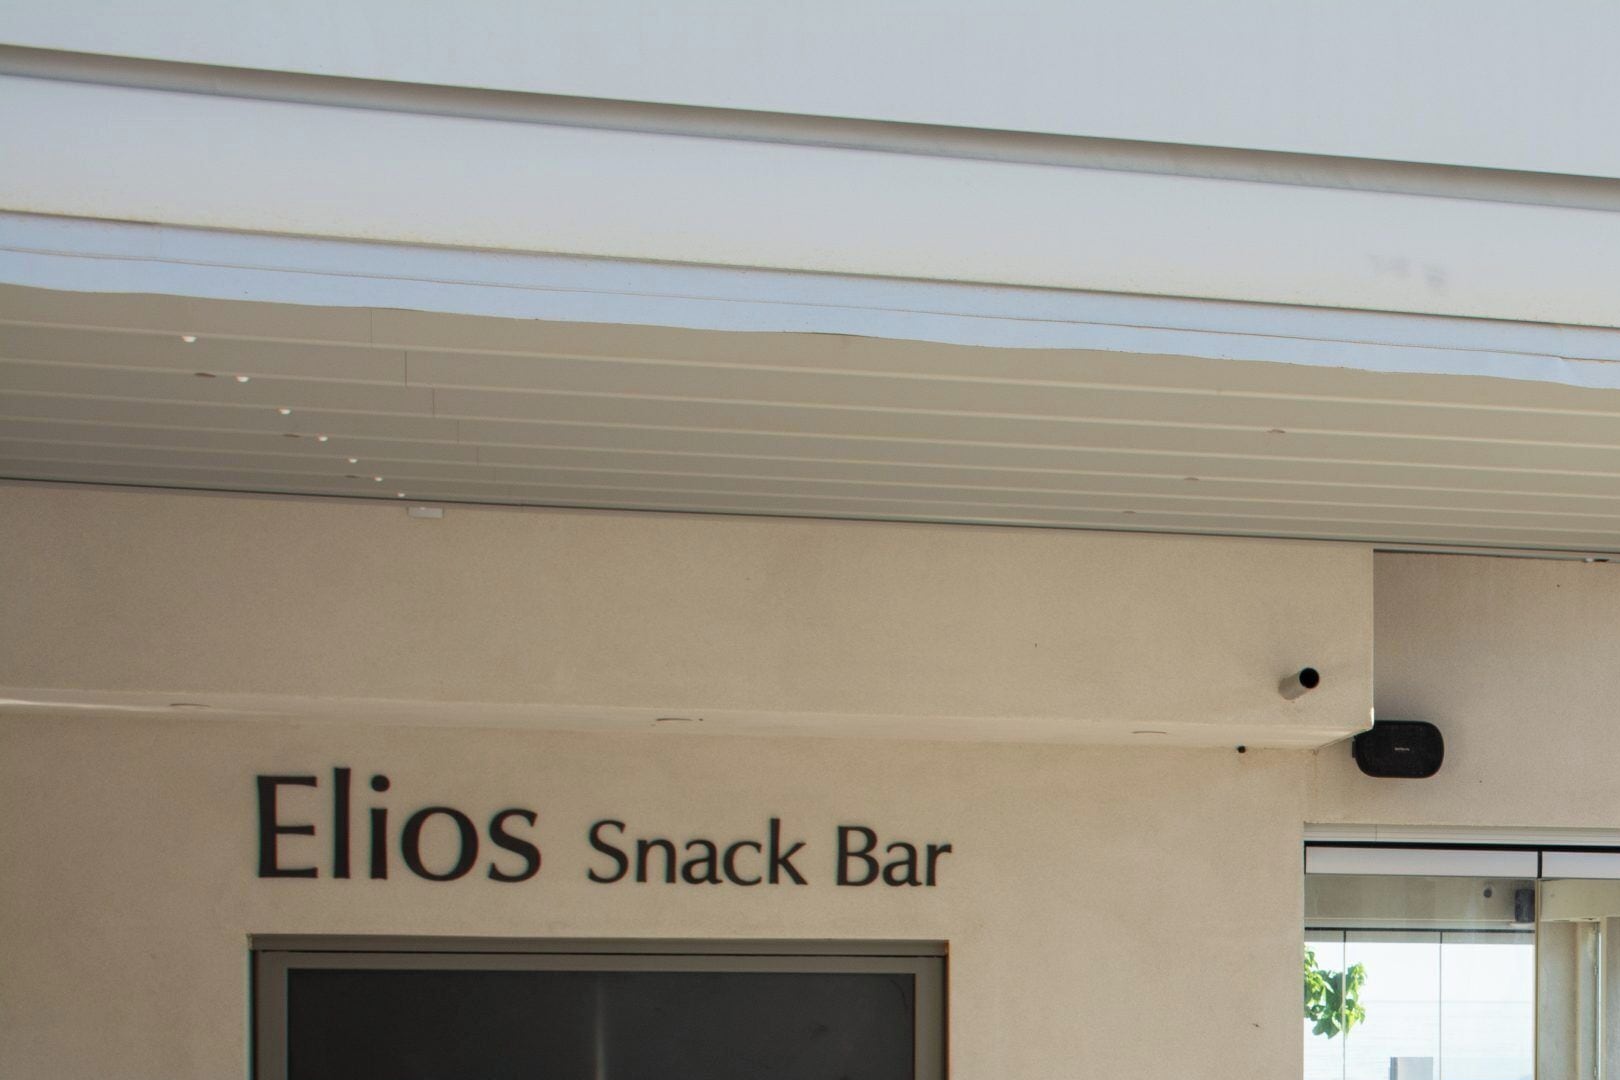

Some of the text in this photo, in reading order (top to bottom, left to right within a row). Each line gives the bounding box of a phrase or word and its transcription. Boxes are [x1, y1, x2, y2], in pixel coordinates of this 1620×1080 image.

[254, 766, 953, 888] Elios Snack Bar
